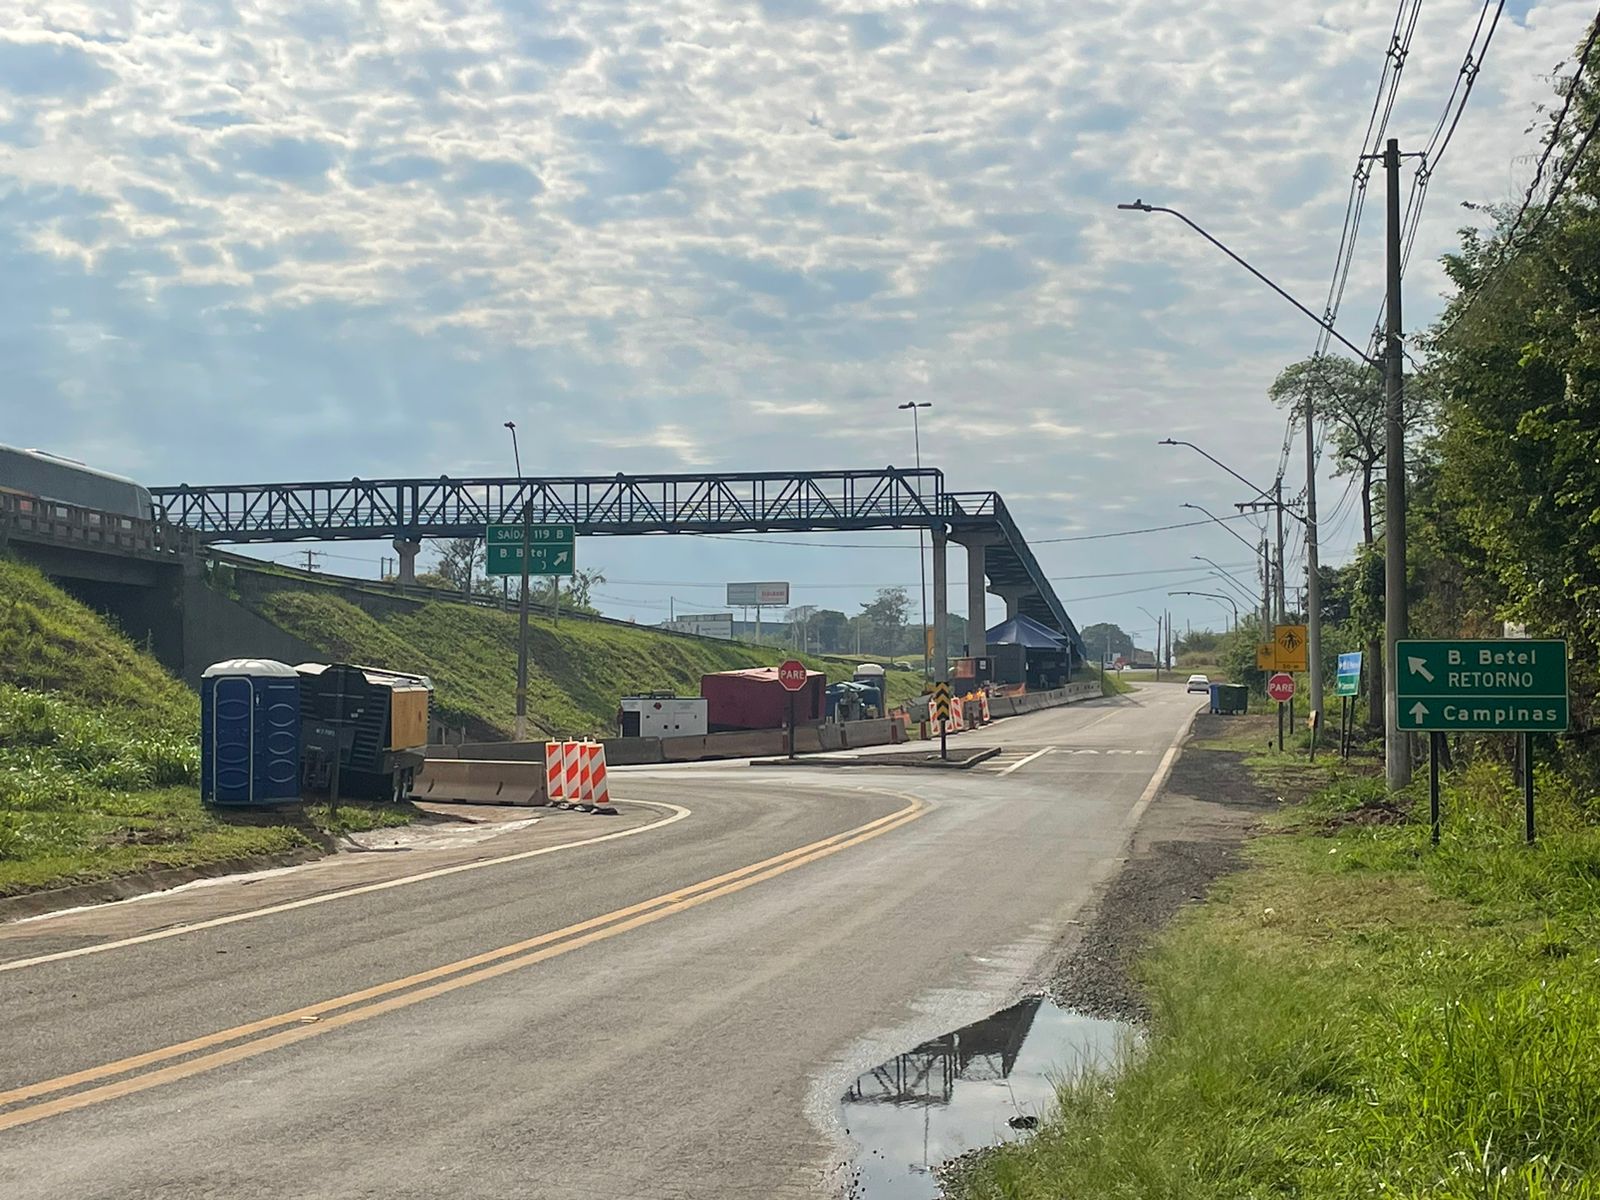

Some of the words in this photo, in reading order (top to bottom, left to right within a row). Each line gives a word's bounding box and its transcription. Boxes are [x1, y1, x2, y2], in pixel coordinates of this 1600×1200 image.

[534, 529, 550, 540] 119
[556, 529, 564, 540] B
[516, 548, 547, 559] Btel
[1448, 650, 1466, 665] B.
[1479, 650, 1536, 665] Betel
[780, 669, 805, 680] PARE
[1448, 672, 1533, 688] RETORNO
[1269, 683, 1293, 693] PARE
[1443, 706, 1557, 725] Campinas
